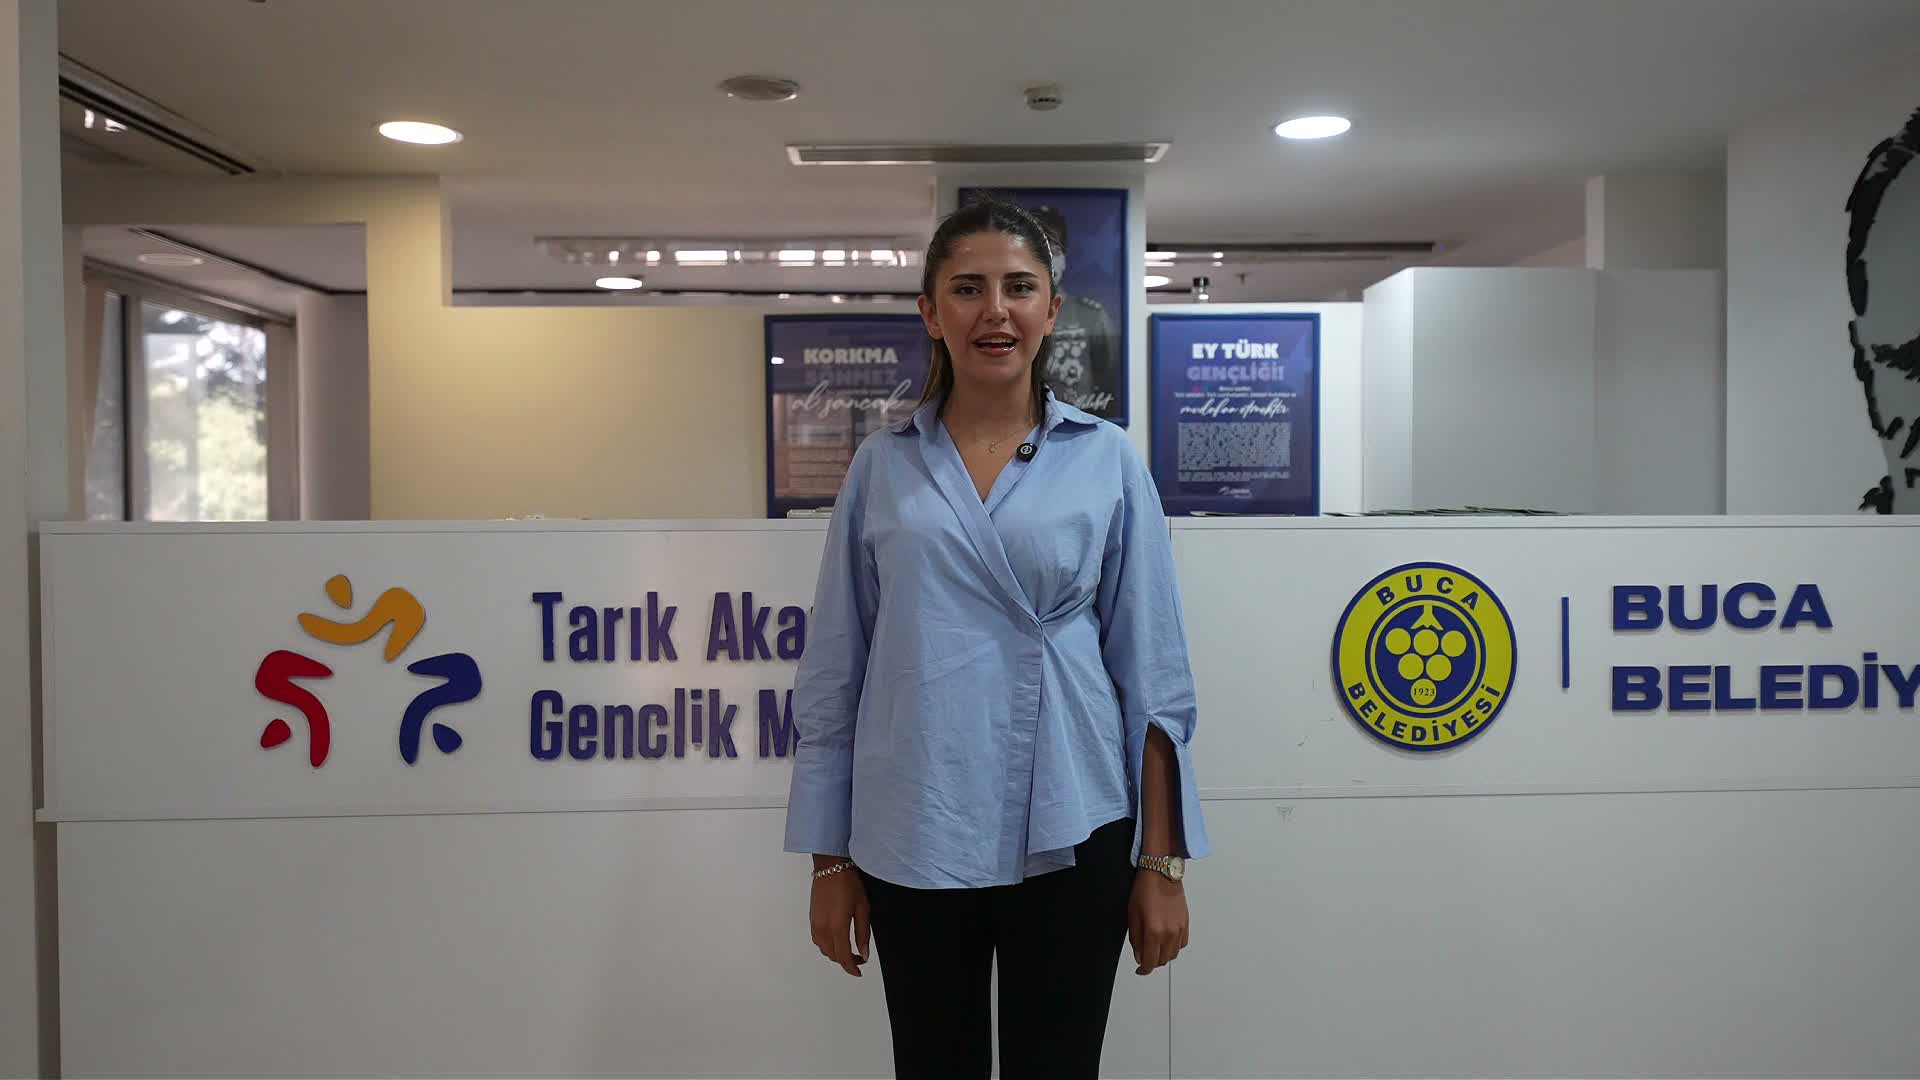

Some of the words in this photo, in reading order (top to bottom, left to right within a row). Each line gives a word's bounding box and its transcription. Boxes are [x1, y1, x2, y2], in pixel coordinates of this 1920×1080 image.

[803, 348, 898, 364] KORKMA
[1191, 343, 1219, 360] EY
[1221, 339, 1280, 360] TÜRK
[1375, 575, 1479, 611] BUCA
[1613, 582, 1834, 630] BUCA
[532, 591, 678, 661] Tarık
[707, 591, 814, 661] Aka
[1413, 687, 1436, 697] 1923
[1348, 682, 1501, 742] BELEDİYESİ
